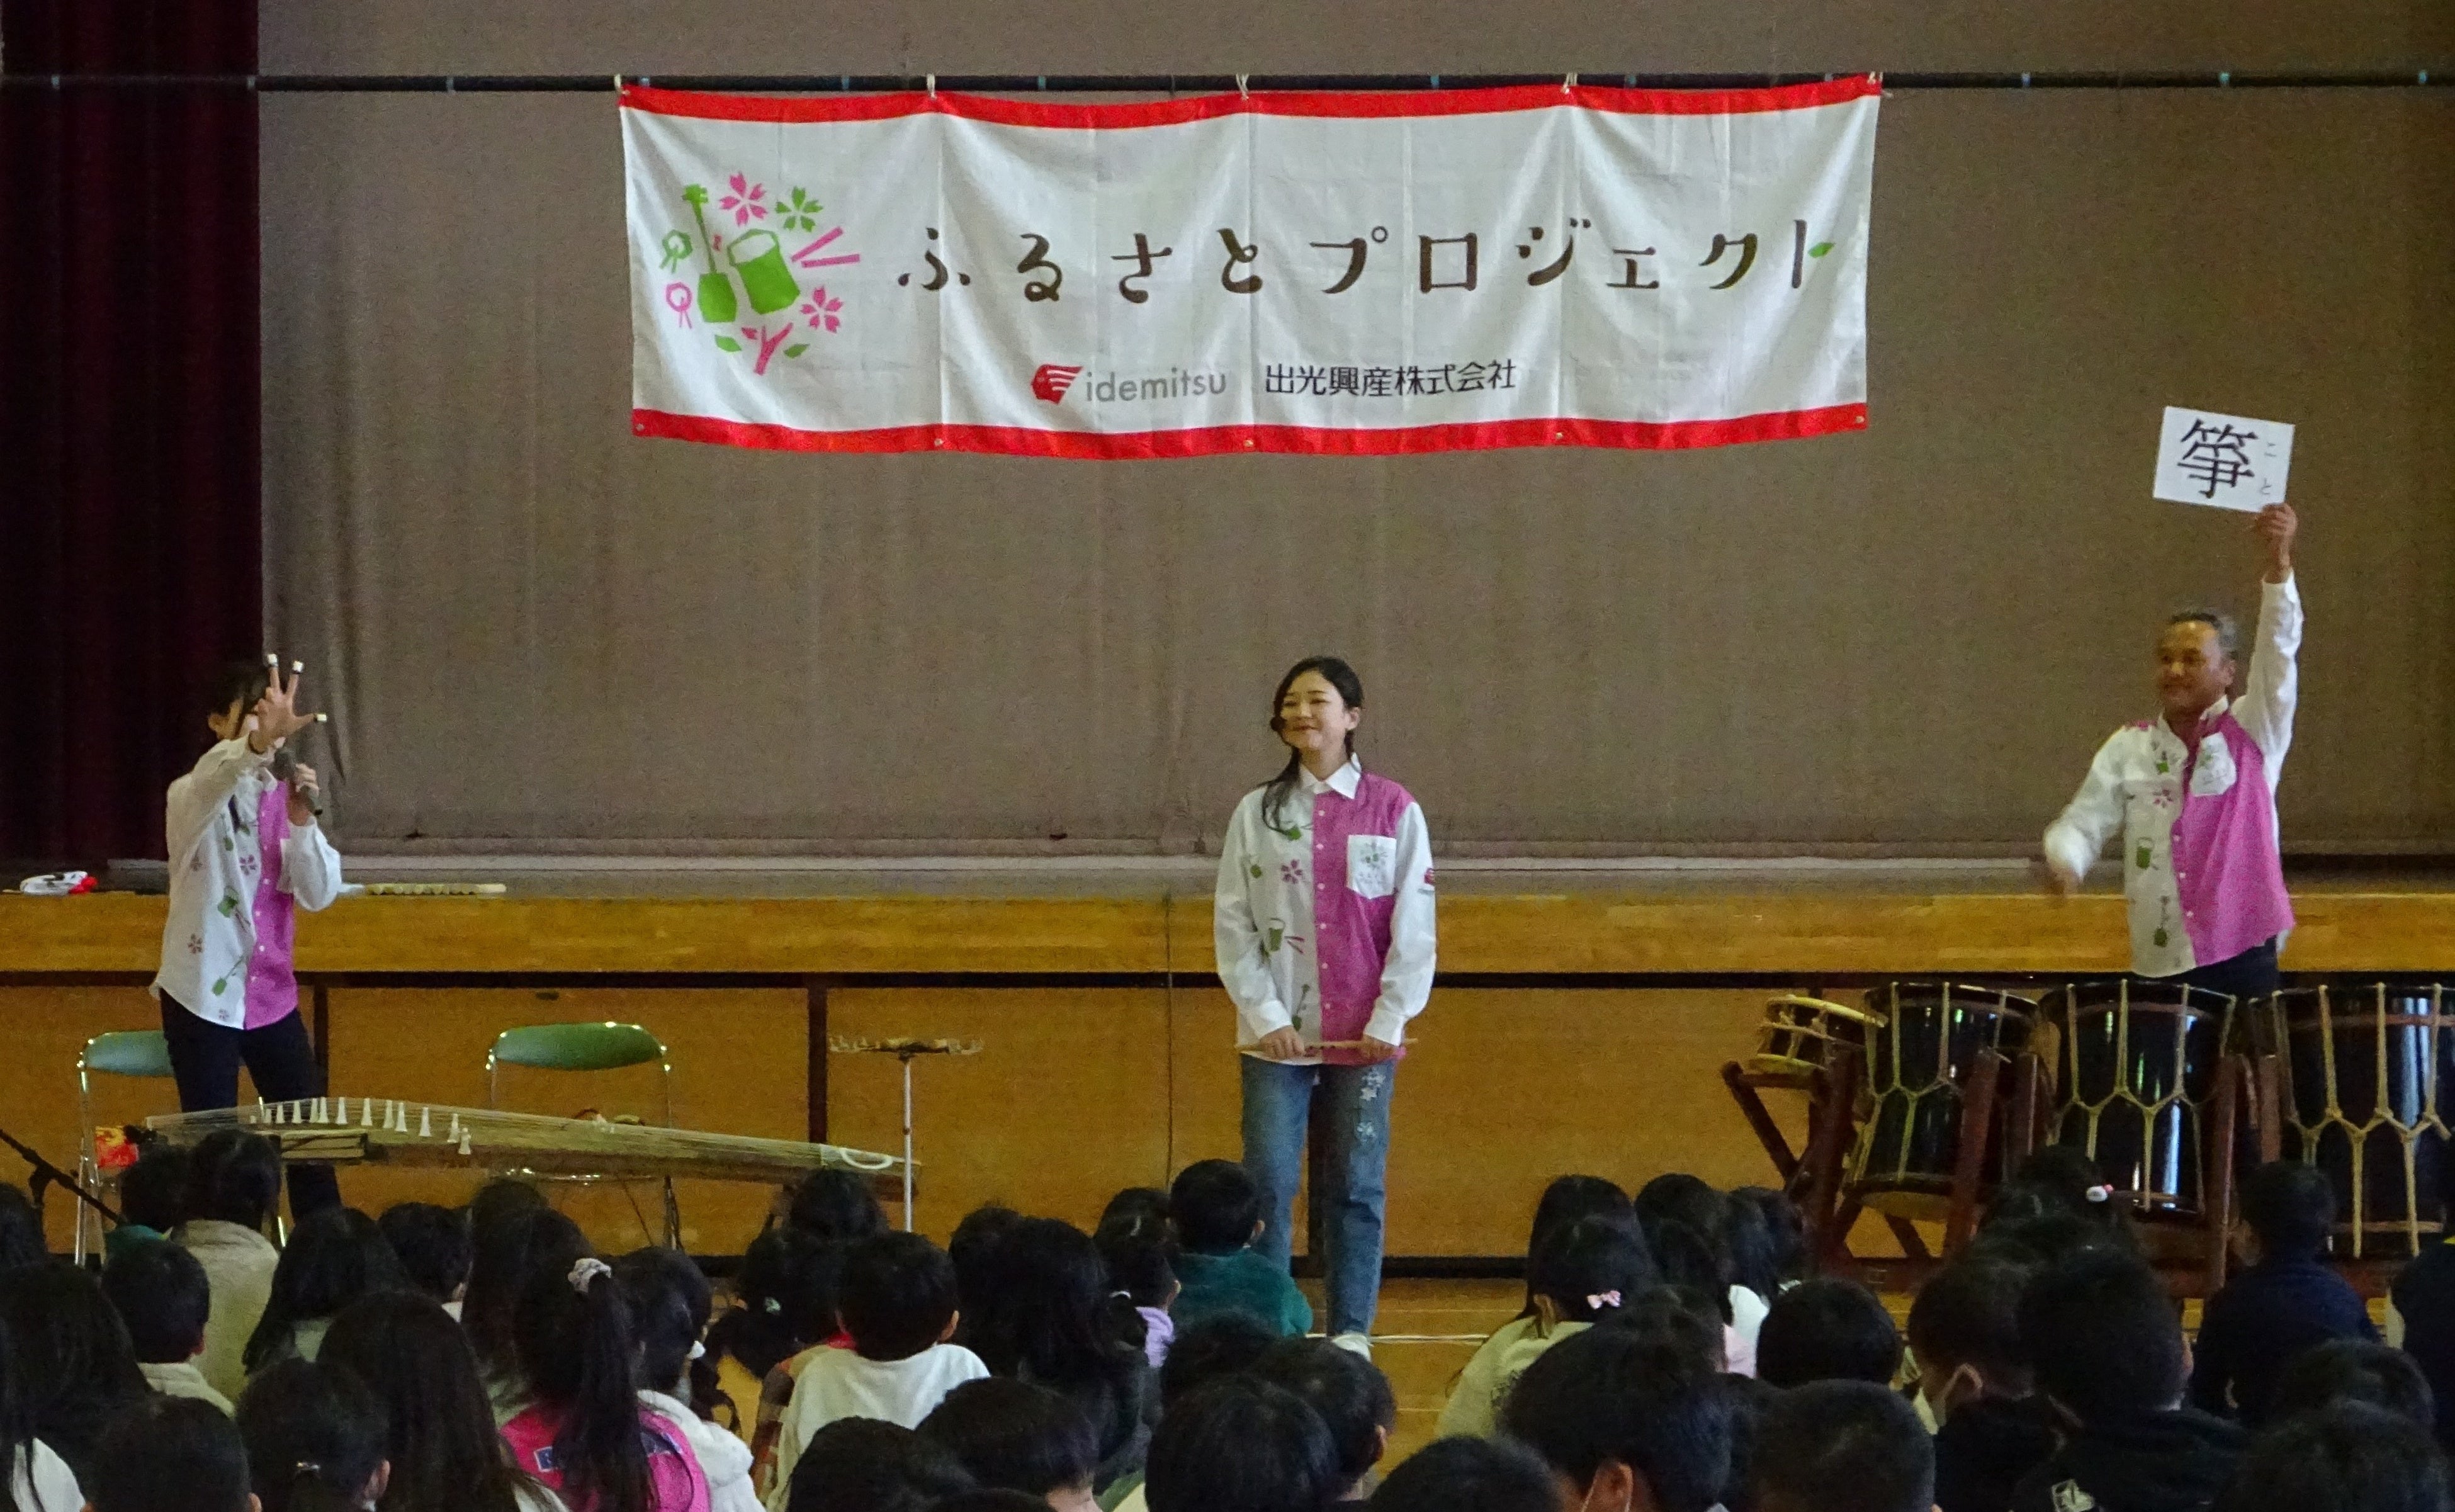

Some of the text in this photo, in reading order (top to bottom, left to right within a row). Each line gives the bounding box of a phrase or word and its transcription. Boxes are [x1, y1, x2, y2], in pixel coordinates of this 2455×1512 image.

[897, 218, 1834, 303] ふるさとプロジェクト
[1085, 366, 1227, 402] idemitsu
[1265, 359, 1516, 397] 出光興産株式会社
